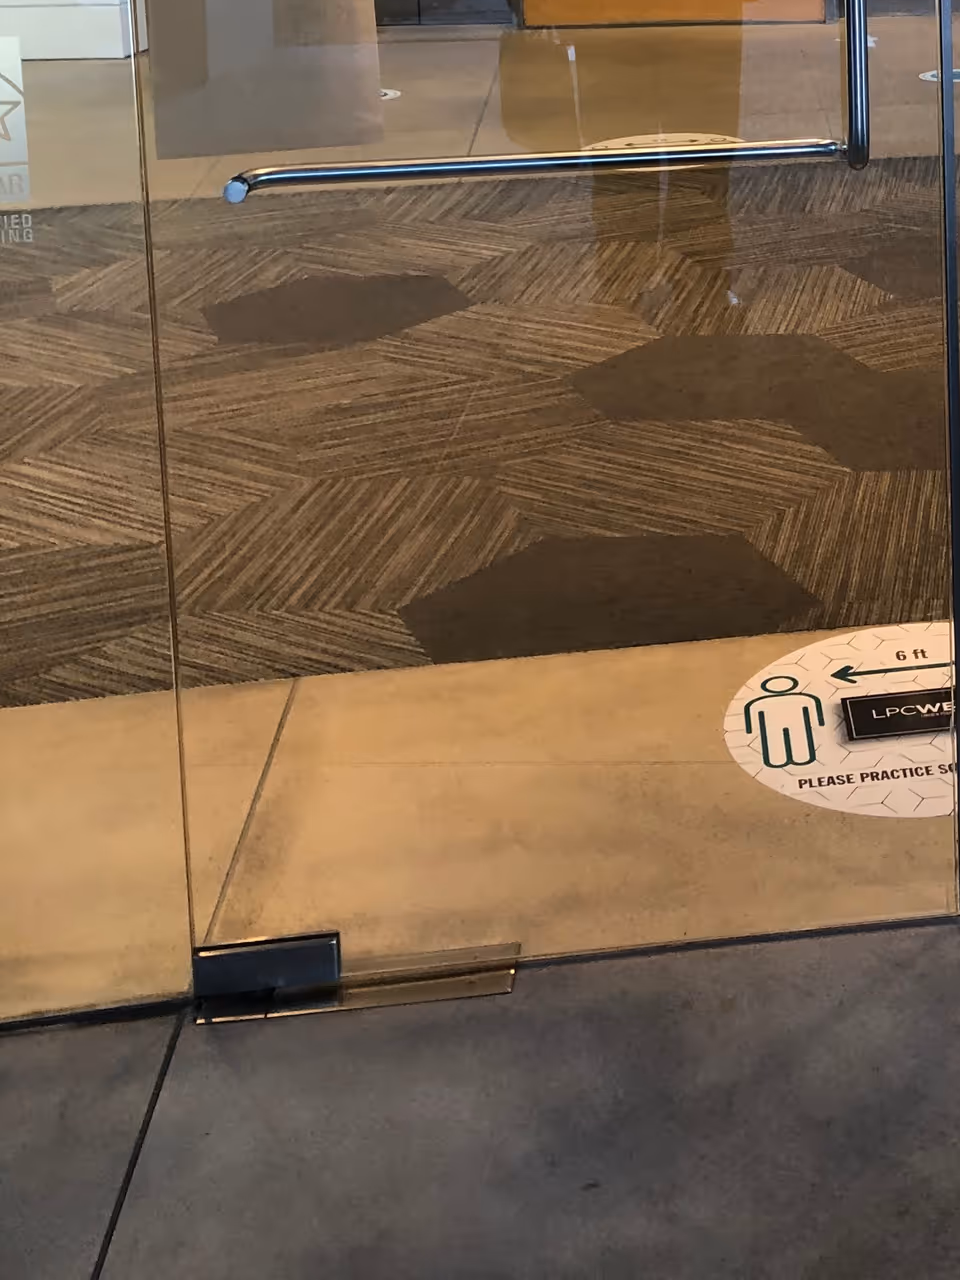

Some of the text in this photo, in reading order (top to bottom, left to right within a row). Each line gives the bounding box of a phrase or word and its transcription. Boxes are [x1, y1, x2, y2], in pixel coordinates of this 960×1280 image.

[895, 648, 928, 661] 6 ft
[798, 773, 855, 790] PLEASE
[860, 764, 934, 784] PRACTICE
